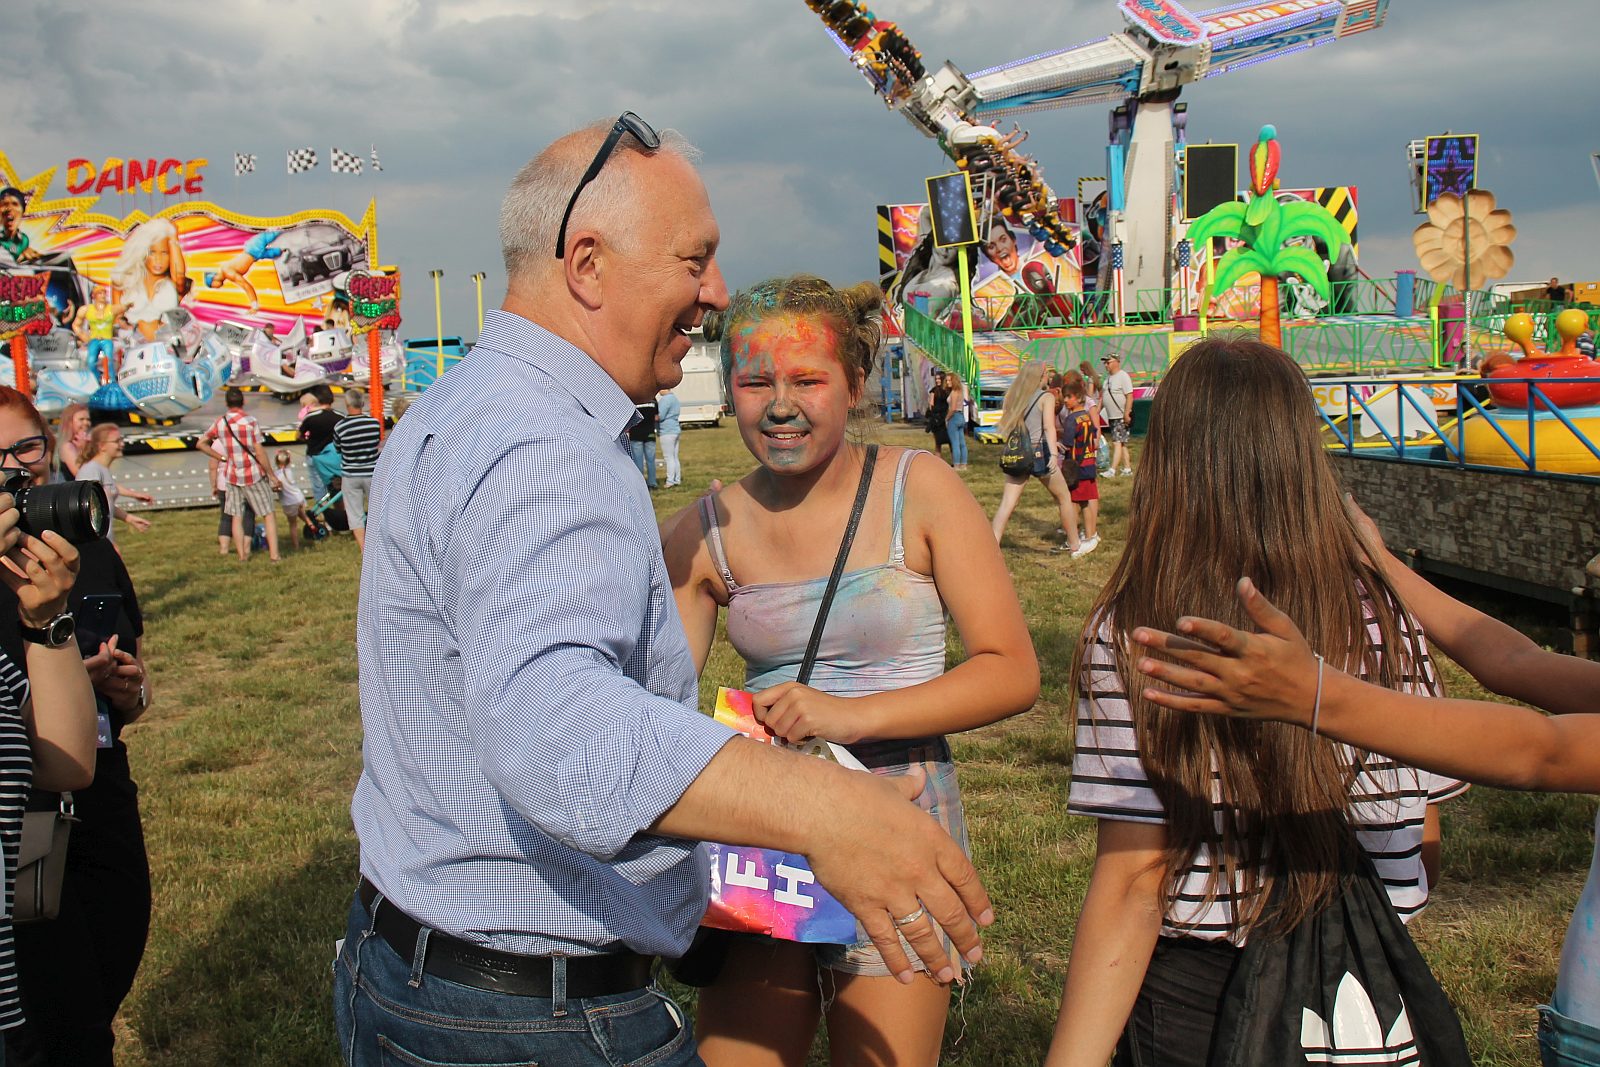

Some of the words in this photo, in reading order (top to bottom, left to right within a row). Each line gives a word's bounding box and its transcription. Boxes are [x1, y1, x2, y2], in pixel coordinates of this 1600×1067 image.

[66, 156, 208, 195] DANCE
[0, 275, 45, 301] REAK
[350, 276, 396, 298] BREAK
[328, 336, 335, 346] 7
[137, 351, 145, 360] 4
